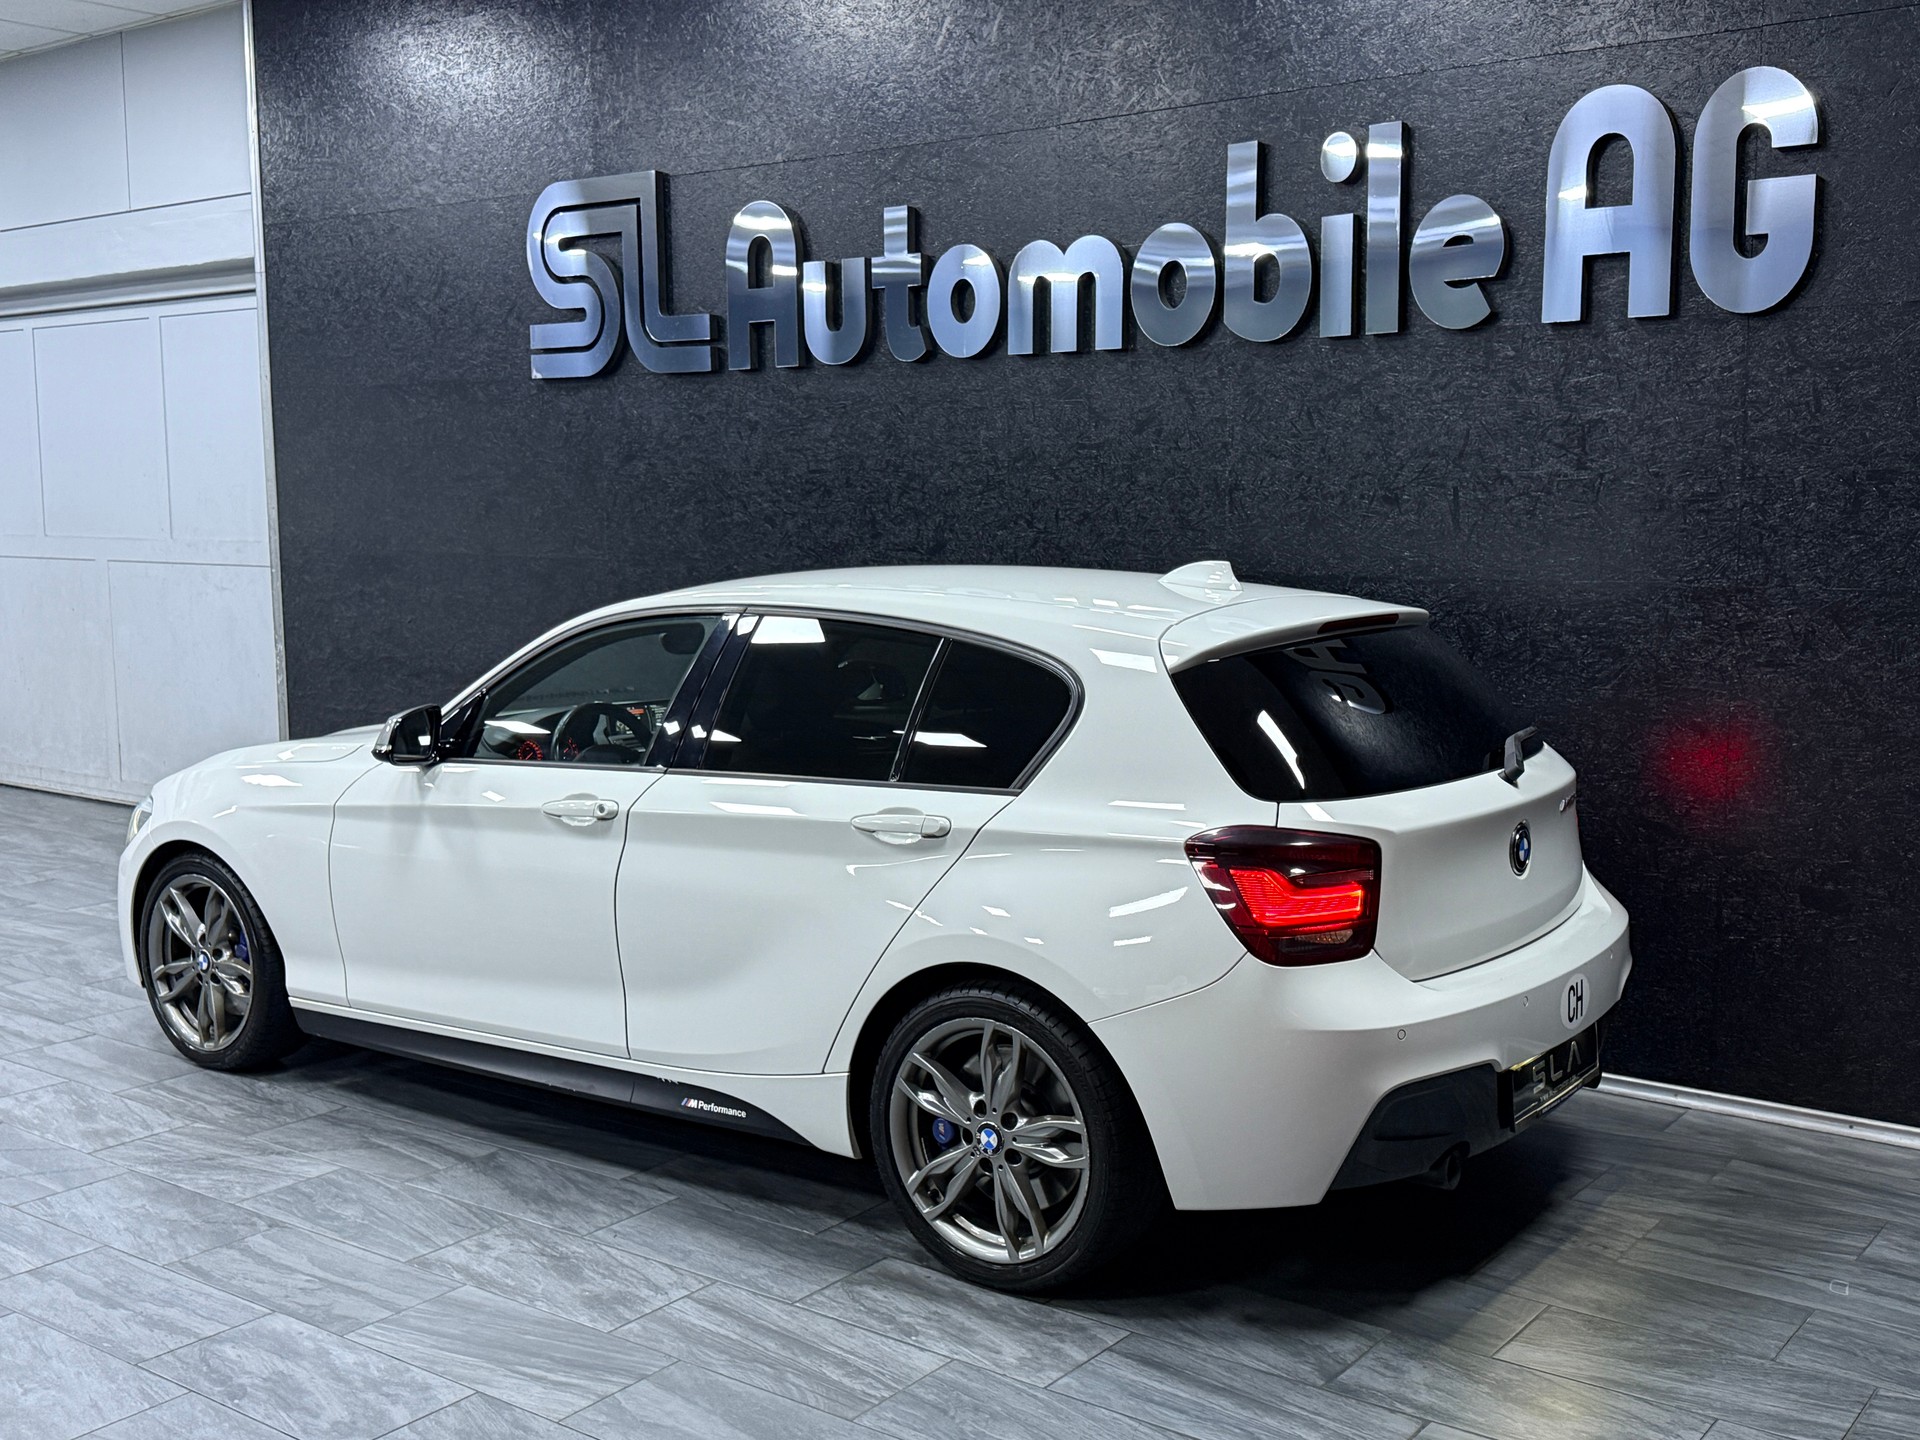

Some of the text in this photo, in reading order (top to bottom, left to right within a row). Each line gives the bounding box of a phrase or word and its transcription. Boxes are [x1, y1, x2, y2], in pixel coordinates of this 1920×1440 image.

[527, 65, 1819, 380] SL Automobile AG
[1567, 979, 1584, 1023] CH
[1532, 1040, 1582, 1095] SLA
[698, 1100, 747, 1118] Performance
